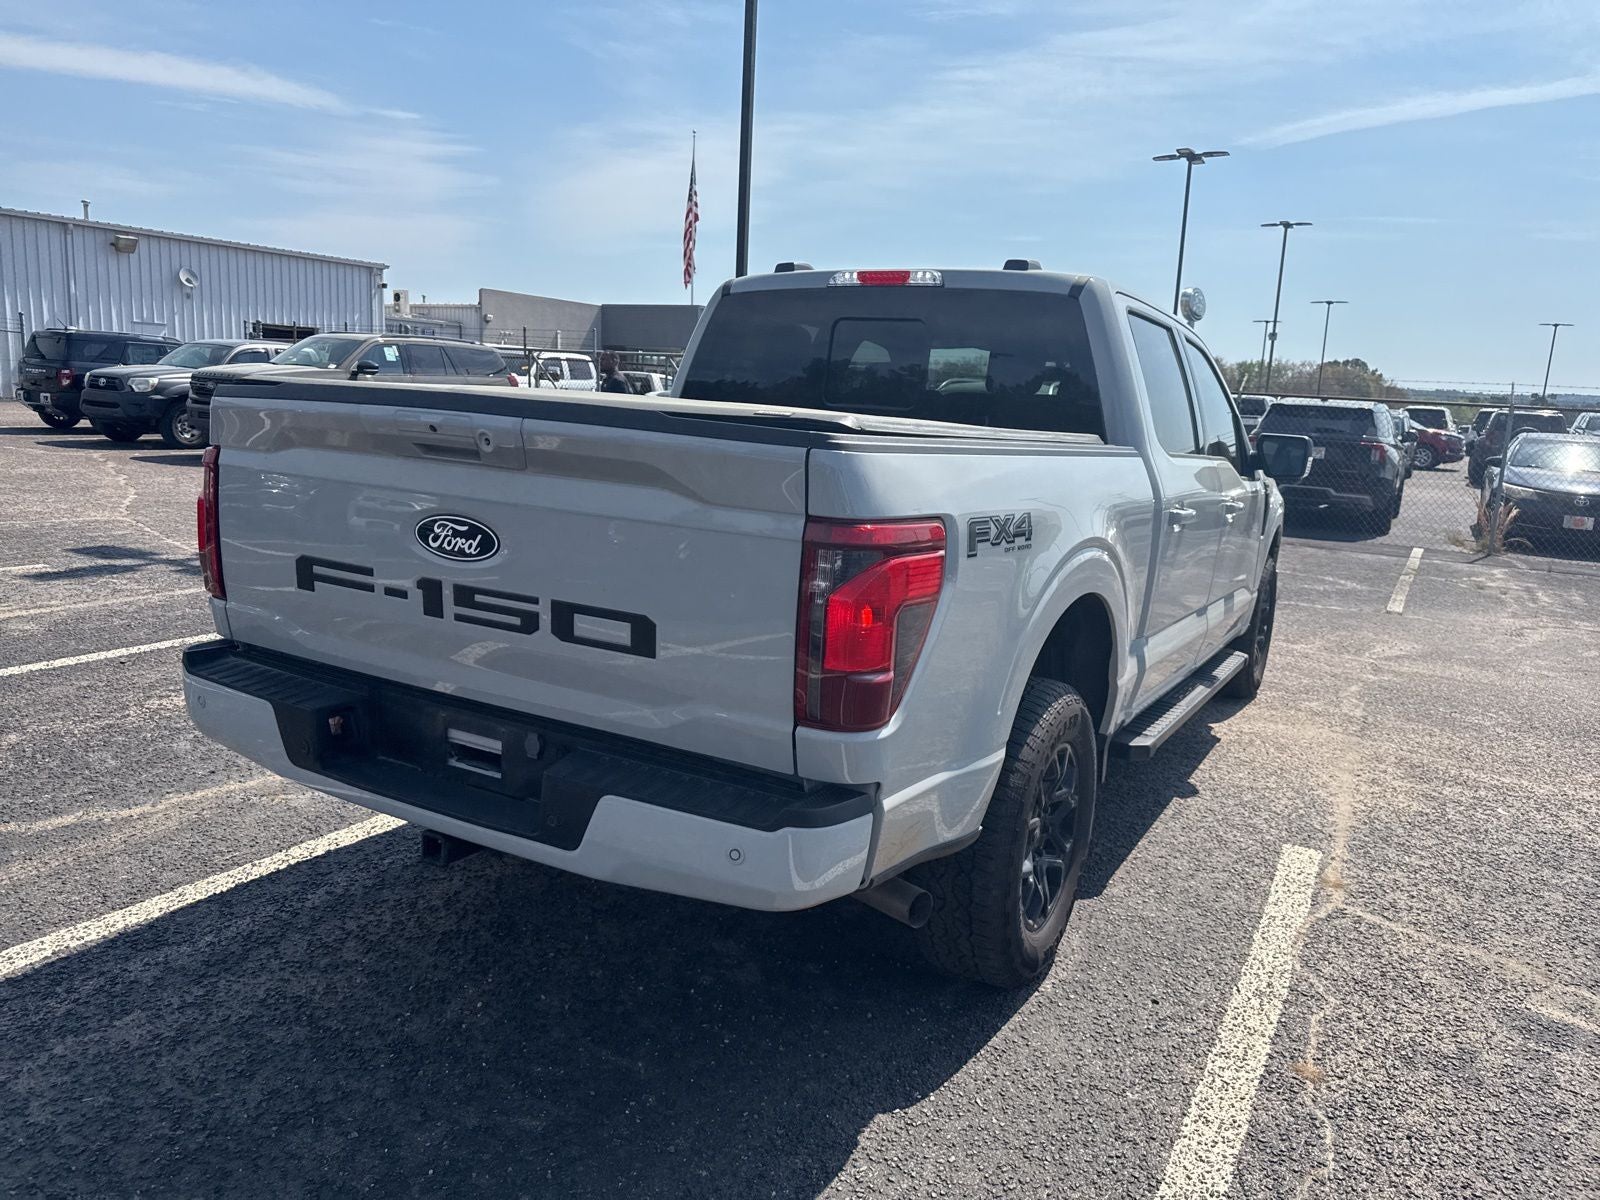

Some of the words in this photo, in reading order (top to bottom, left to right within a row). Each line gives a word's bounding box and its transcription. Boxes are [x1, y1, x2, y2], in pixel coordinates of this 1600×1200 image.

[428, 520, 482, 555] Ford
[966, 512, 1032, 558] FX4
[1017, 543, 1032, 551] ROAD
[295, 554, 657, 660] F-150
